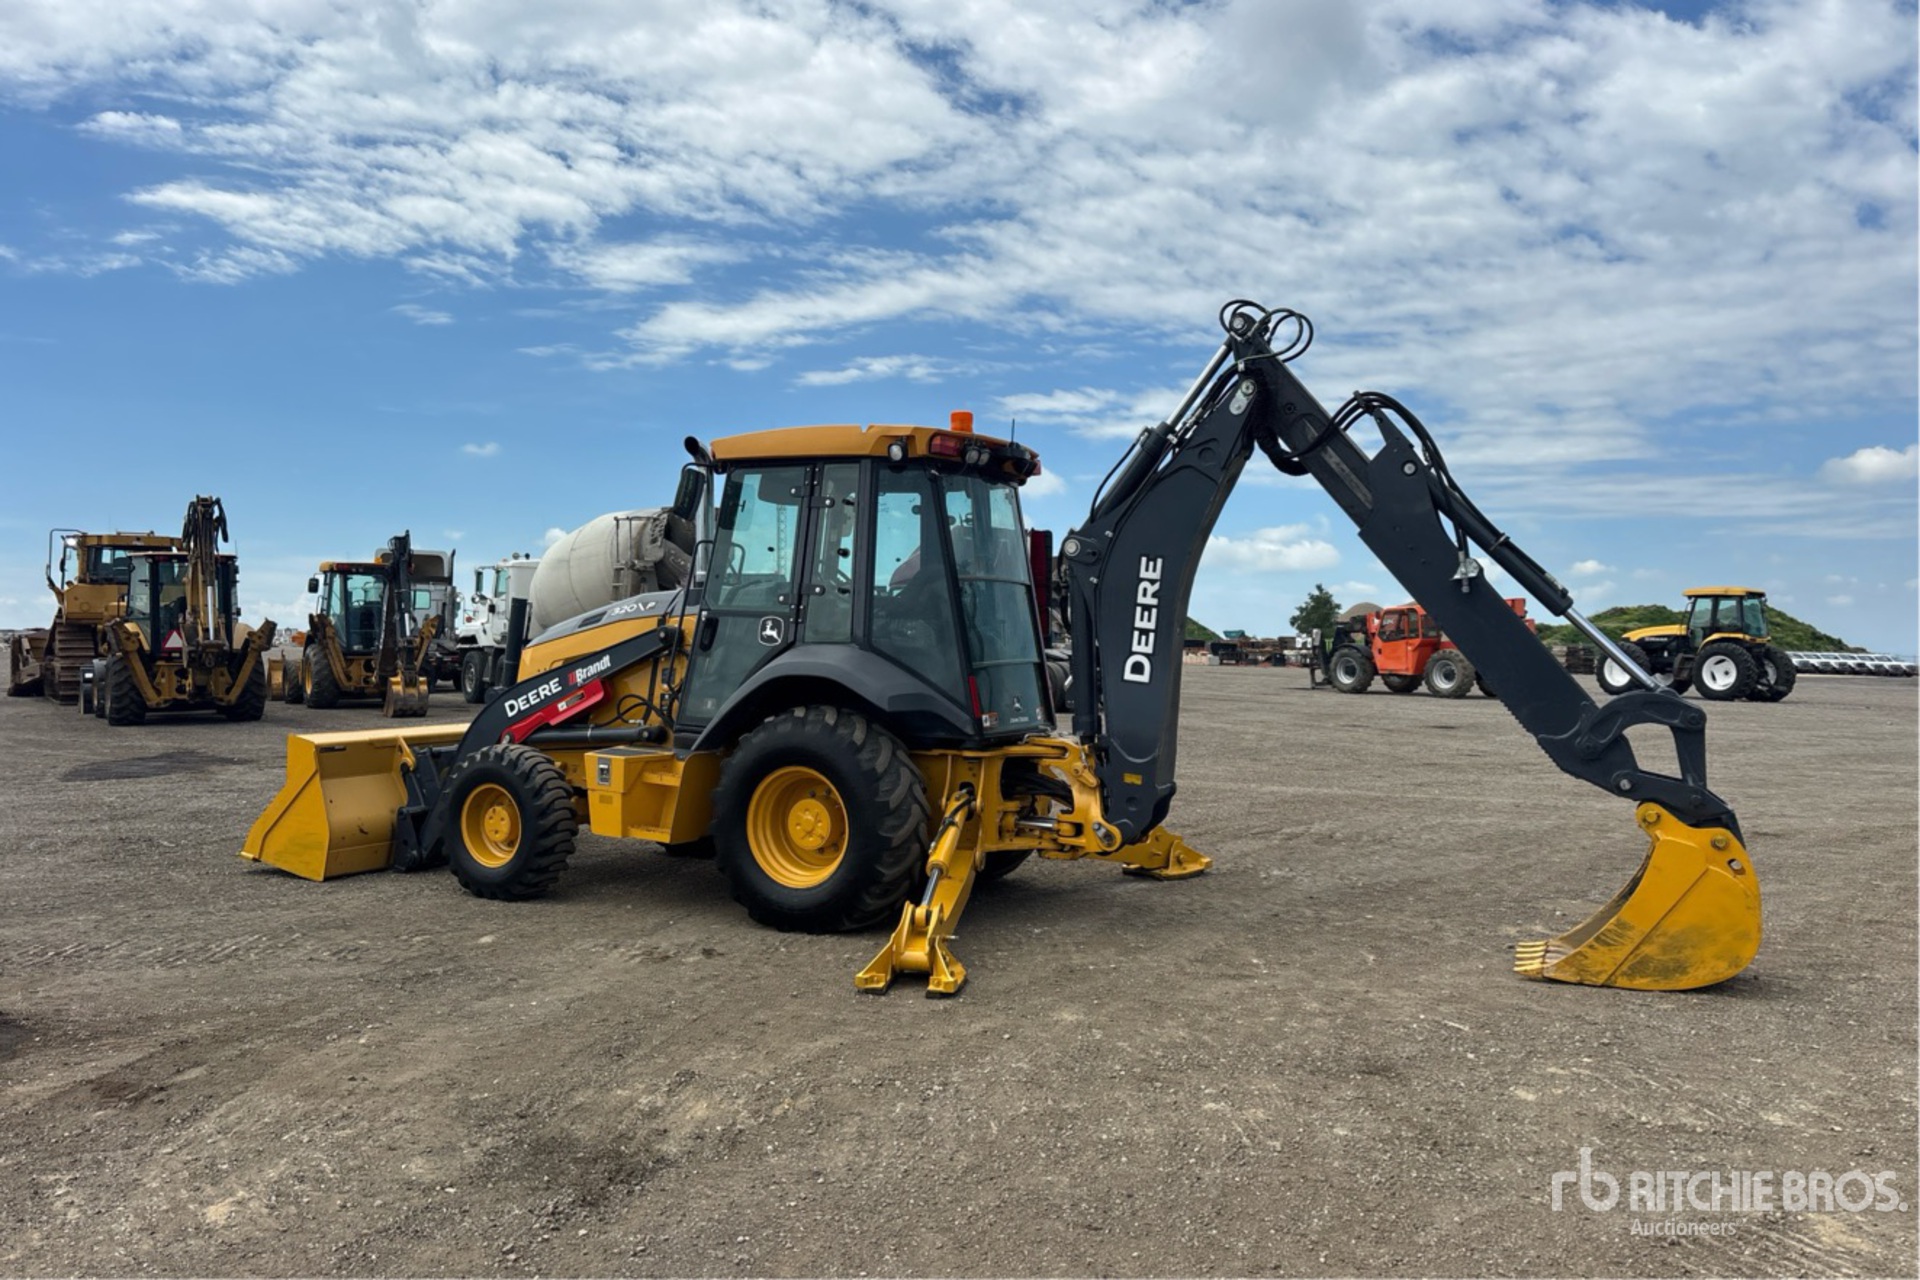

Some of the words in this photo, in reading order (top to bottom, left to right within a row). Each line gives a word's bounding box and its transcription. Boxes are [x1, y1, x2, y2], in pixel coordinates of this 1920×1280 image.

[1123, 556, 1162, 683] DEERE
[574, 654, 612, 682] Brandt
[504, 677, 562, 718] DEERE
